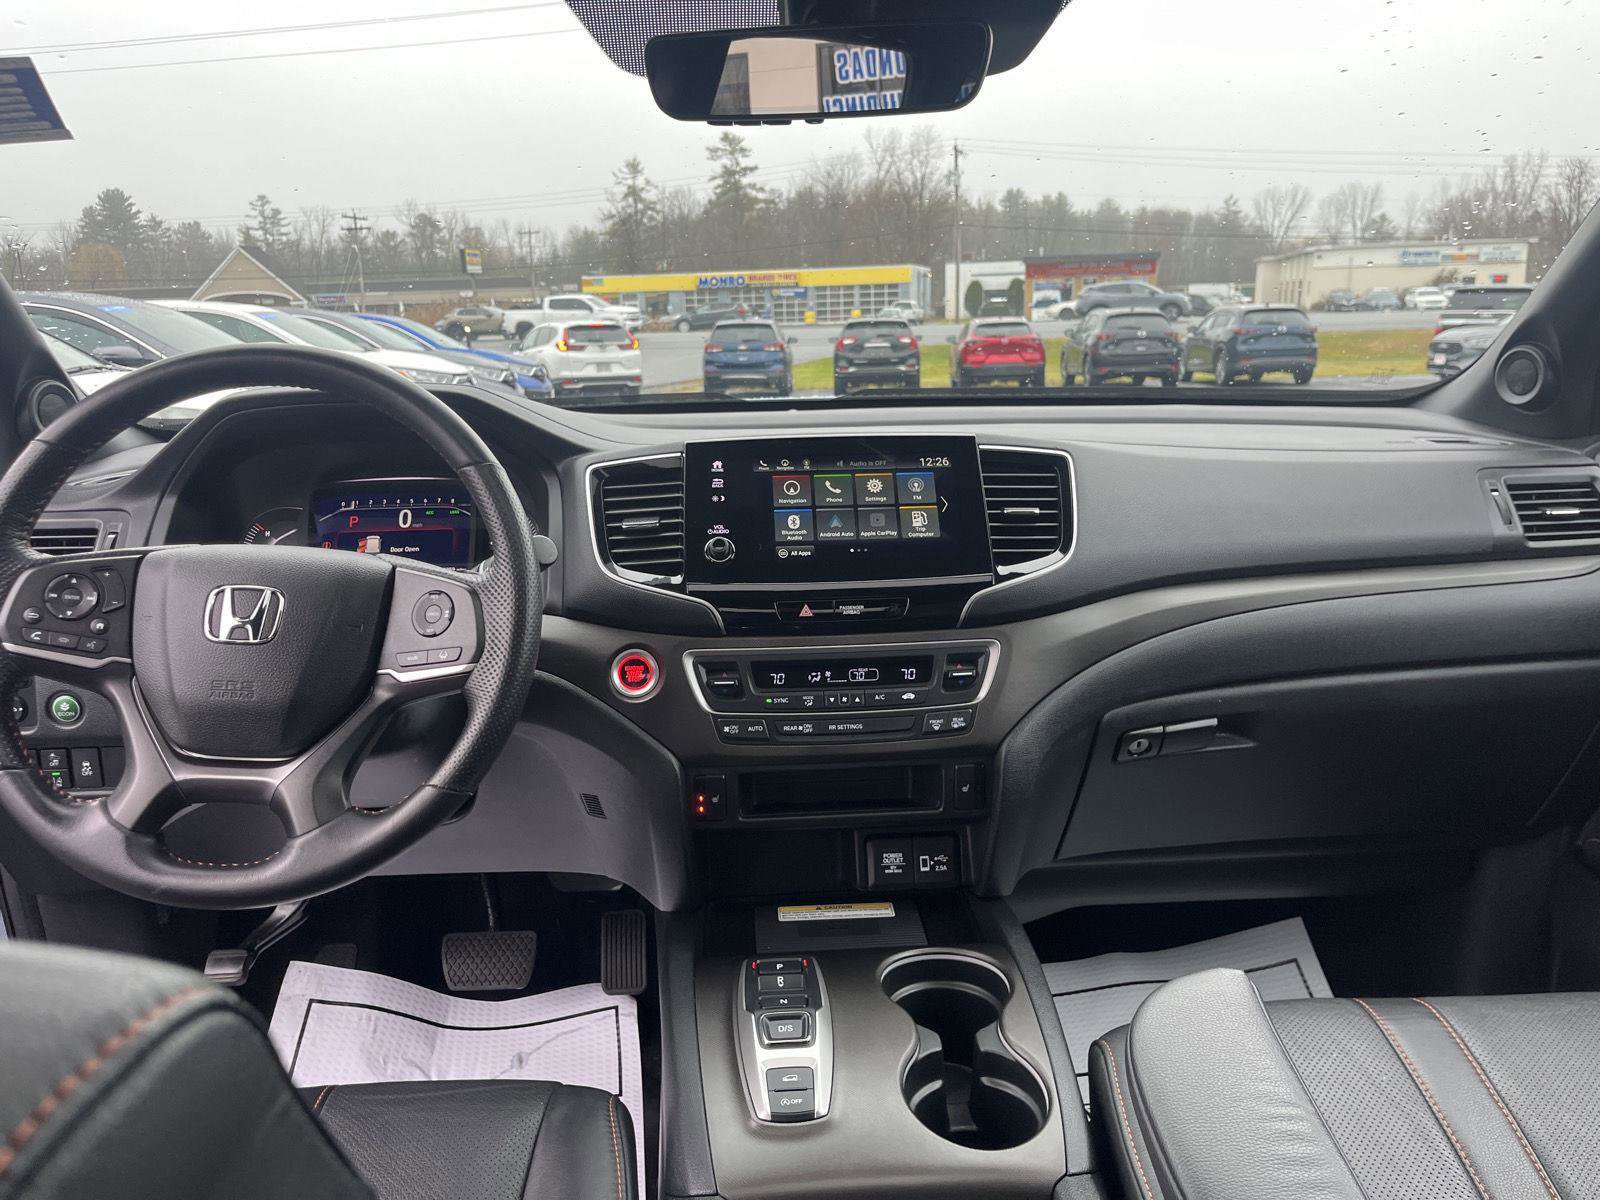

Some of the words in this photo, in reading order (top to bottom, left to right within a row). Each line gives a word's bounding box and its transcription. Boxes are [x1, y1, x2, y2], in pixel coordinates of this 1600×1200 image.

[699, 275, 746, 288] MONRO
[919, 457, 949, 467] 12:26
[349, 515, 359, 528] P
[398, 509, 413, 529] 0
[770, 673, 785, 685] 70
[853, 671, 865, 681] 70
[901, 668, 916, 680] 70
